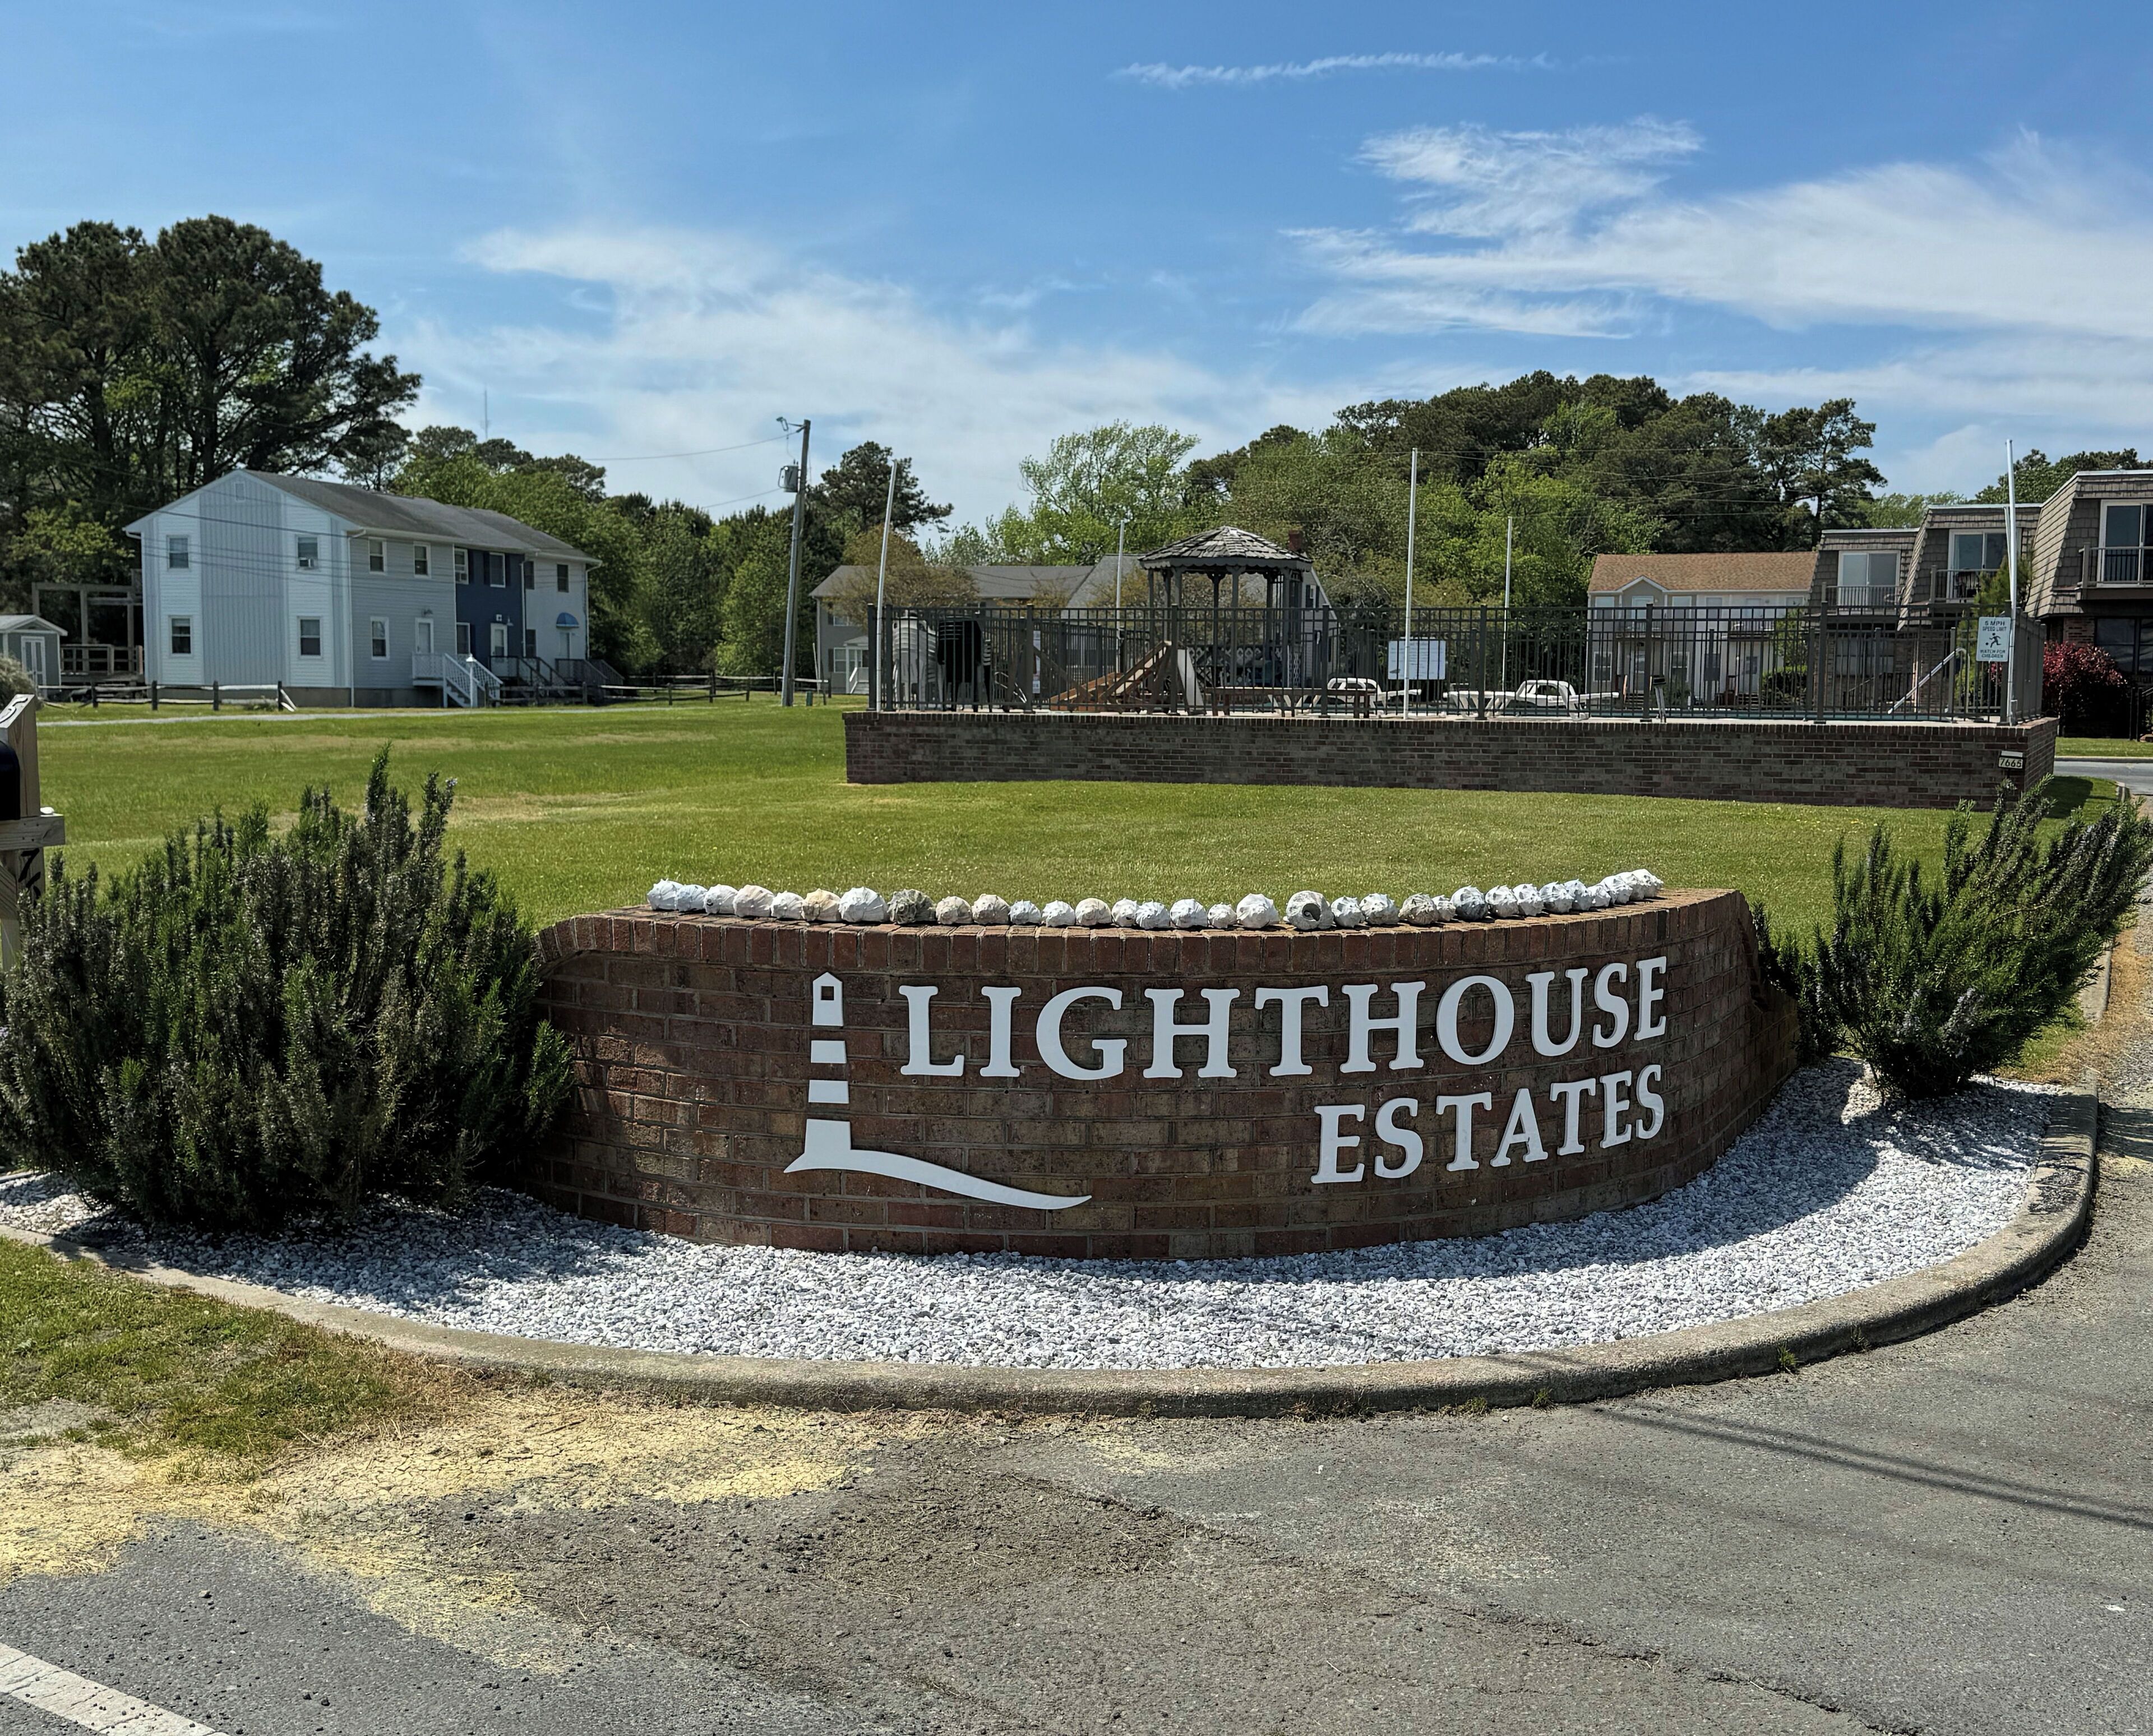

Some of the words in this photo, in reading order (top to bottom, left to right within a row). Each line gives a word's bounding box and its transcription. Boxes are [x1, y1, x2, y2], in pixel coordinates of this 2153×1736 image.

[2000, 758, 2022, 767] 7665
[899, 956, 1667, 1081] LIGHTHOUSE
[1311, 1064, 1664, 1184] ESTATES
